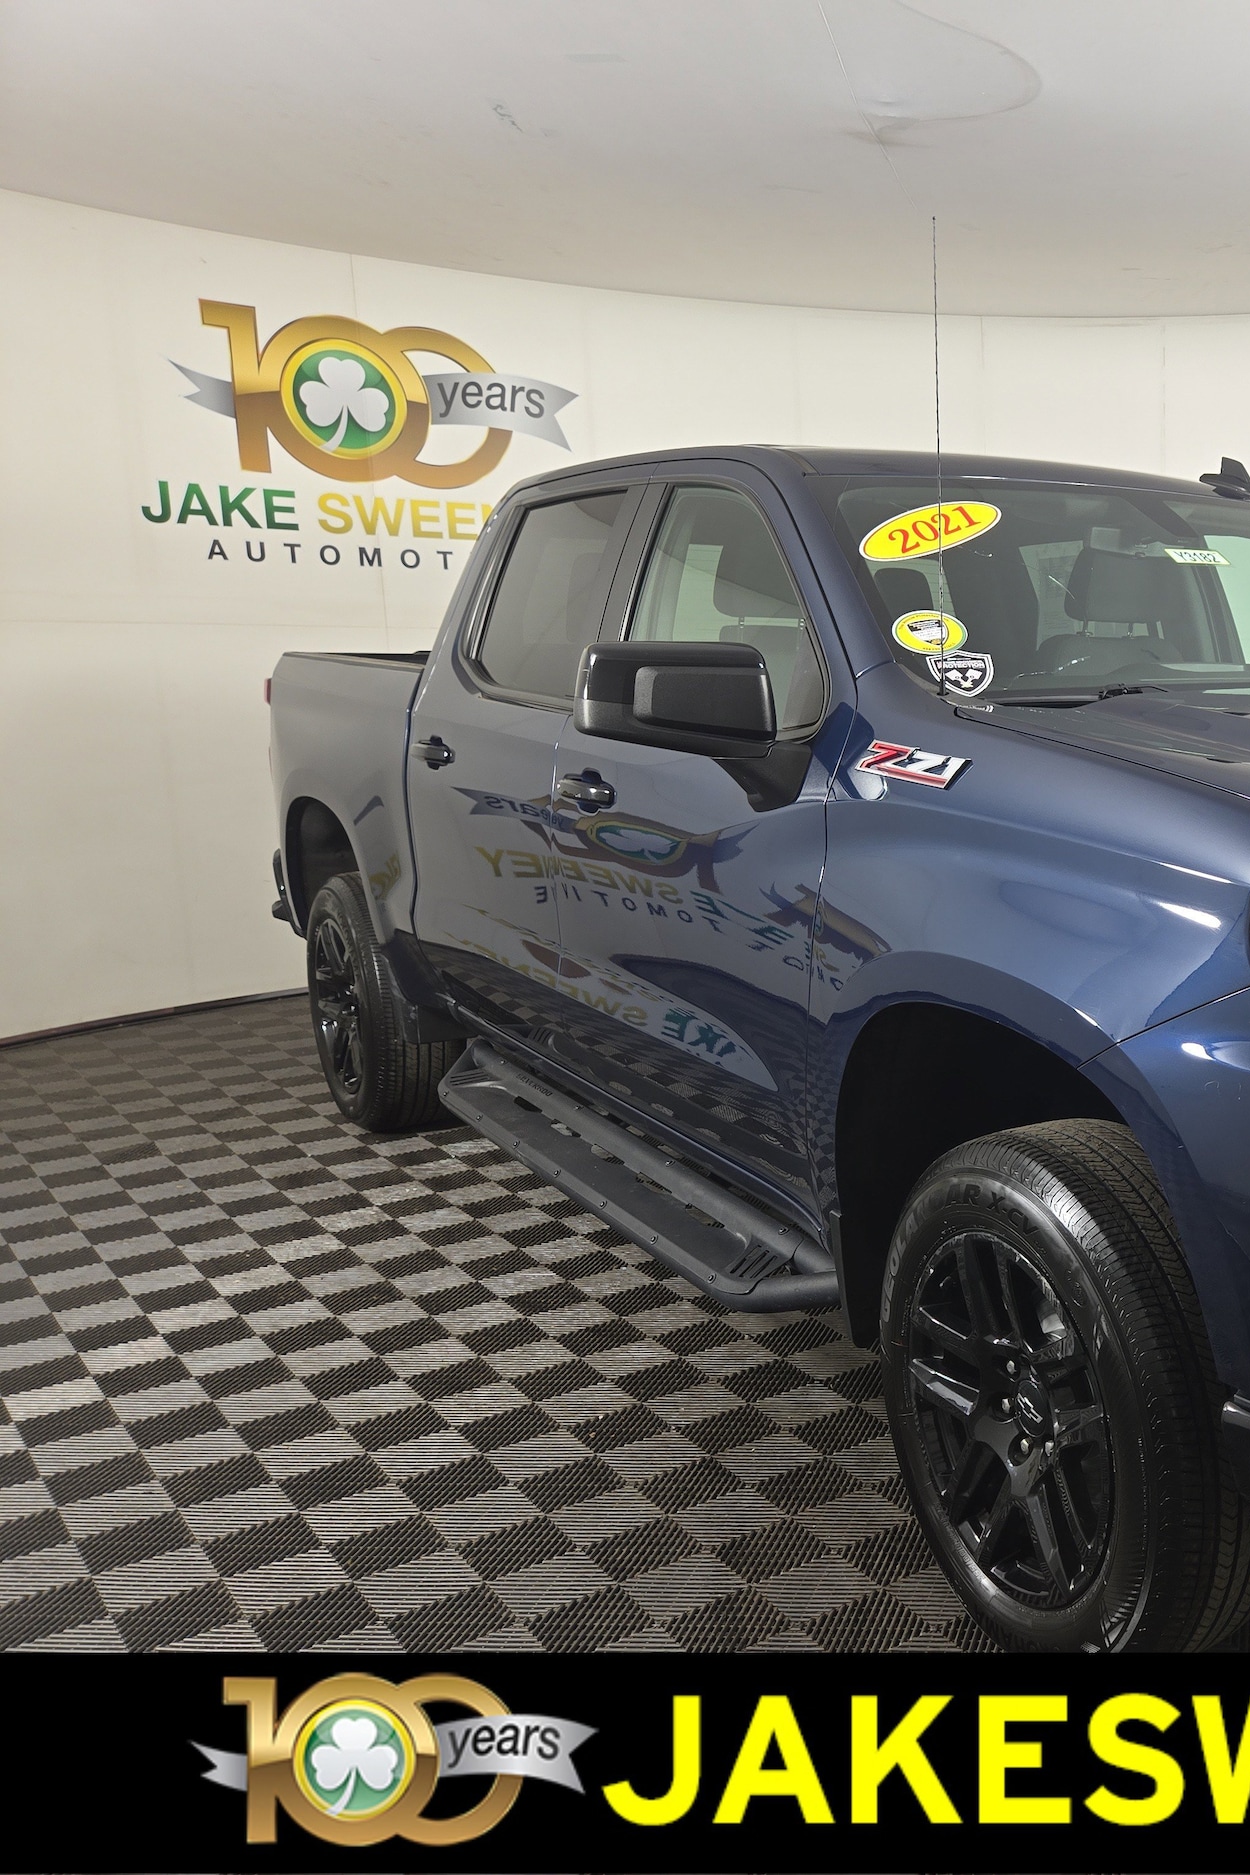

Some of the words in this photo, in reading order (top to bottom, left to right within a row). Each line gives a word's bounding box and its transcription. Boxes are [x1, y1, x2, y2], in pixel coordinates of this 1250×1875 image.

[437, 378, 546, 418] years
[141, 480, 300, 531] JAKE
[317, 492, 494, 541] SWEE
[888, 505, 981, 554] 2021
[207, 539, 455, 571] AUTOMOT
[855, 739, 975, 791] Z71
